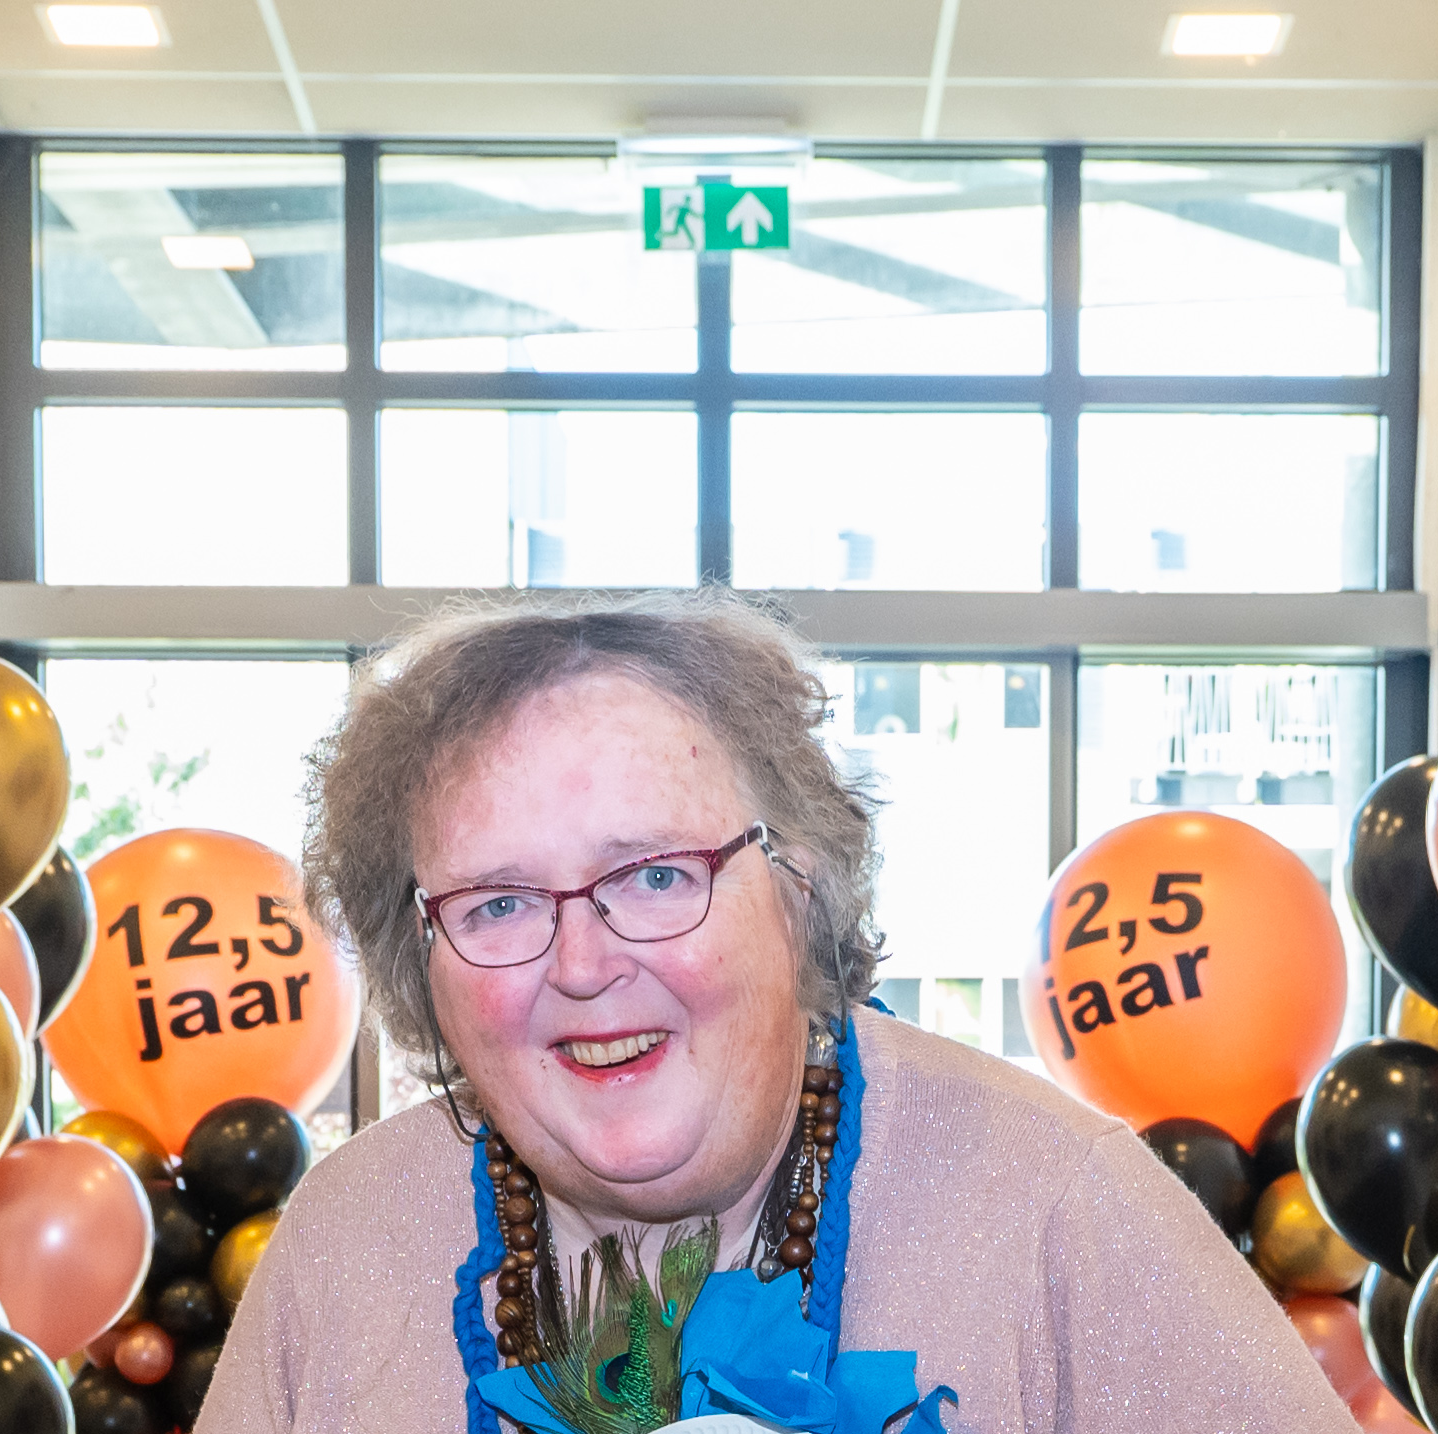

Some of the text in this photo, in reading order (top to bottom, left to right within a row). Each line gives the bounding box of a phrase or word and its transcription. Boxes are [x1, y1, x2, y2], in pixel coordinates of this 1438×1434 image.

[106, 895, 304, 971] 12,5
[135, 972, 310, 1062] jaar
[1044, 945, 1210, 1061] jaar
